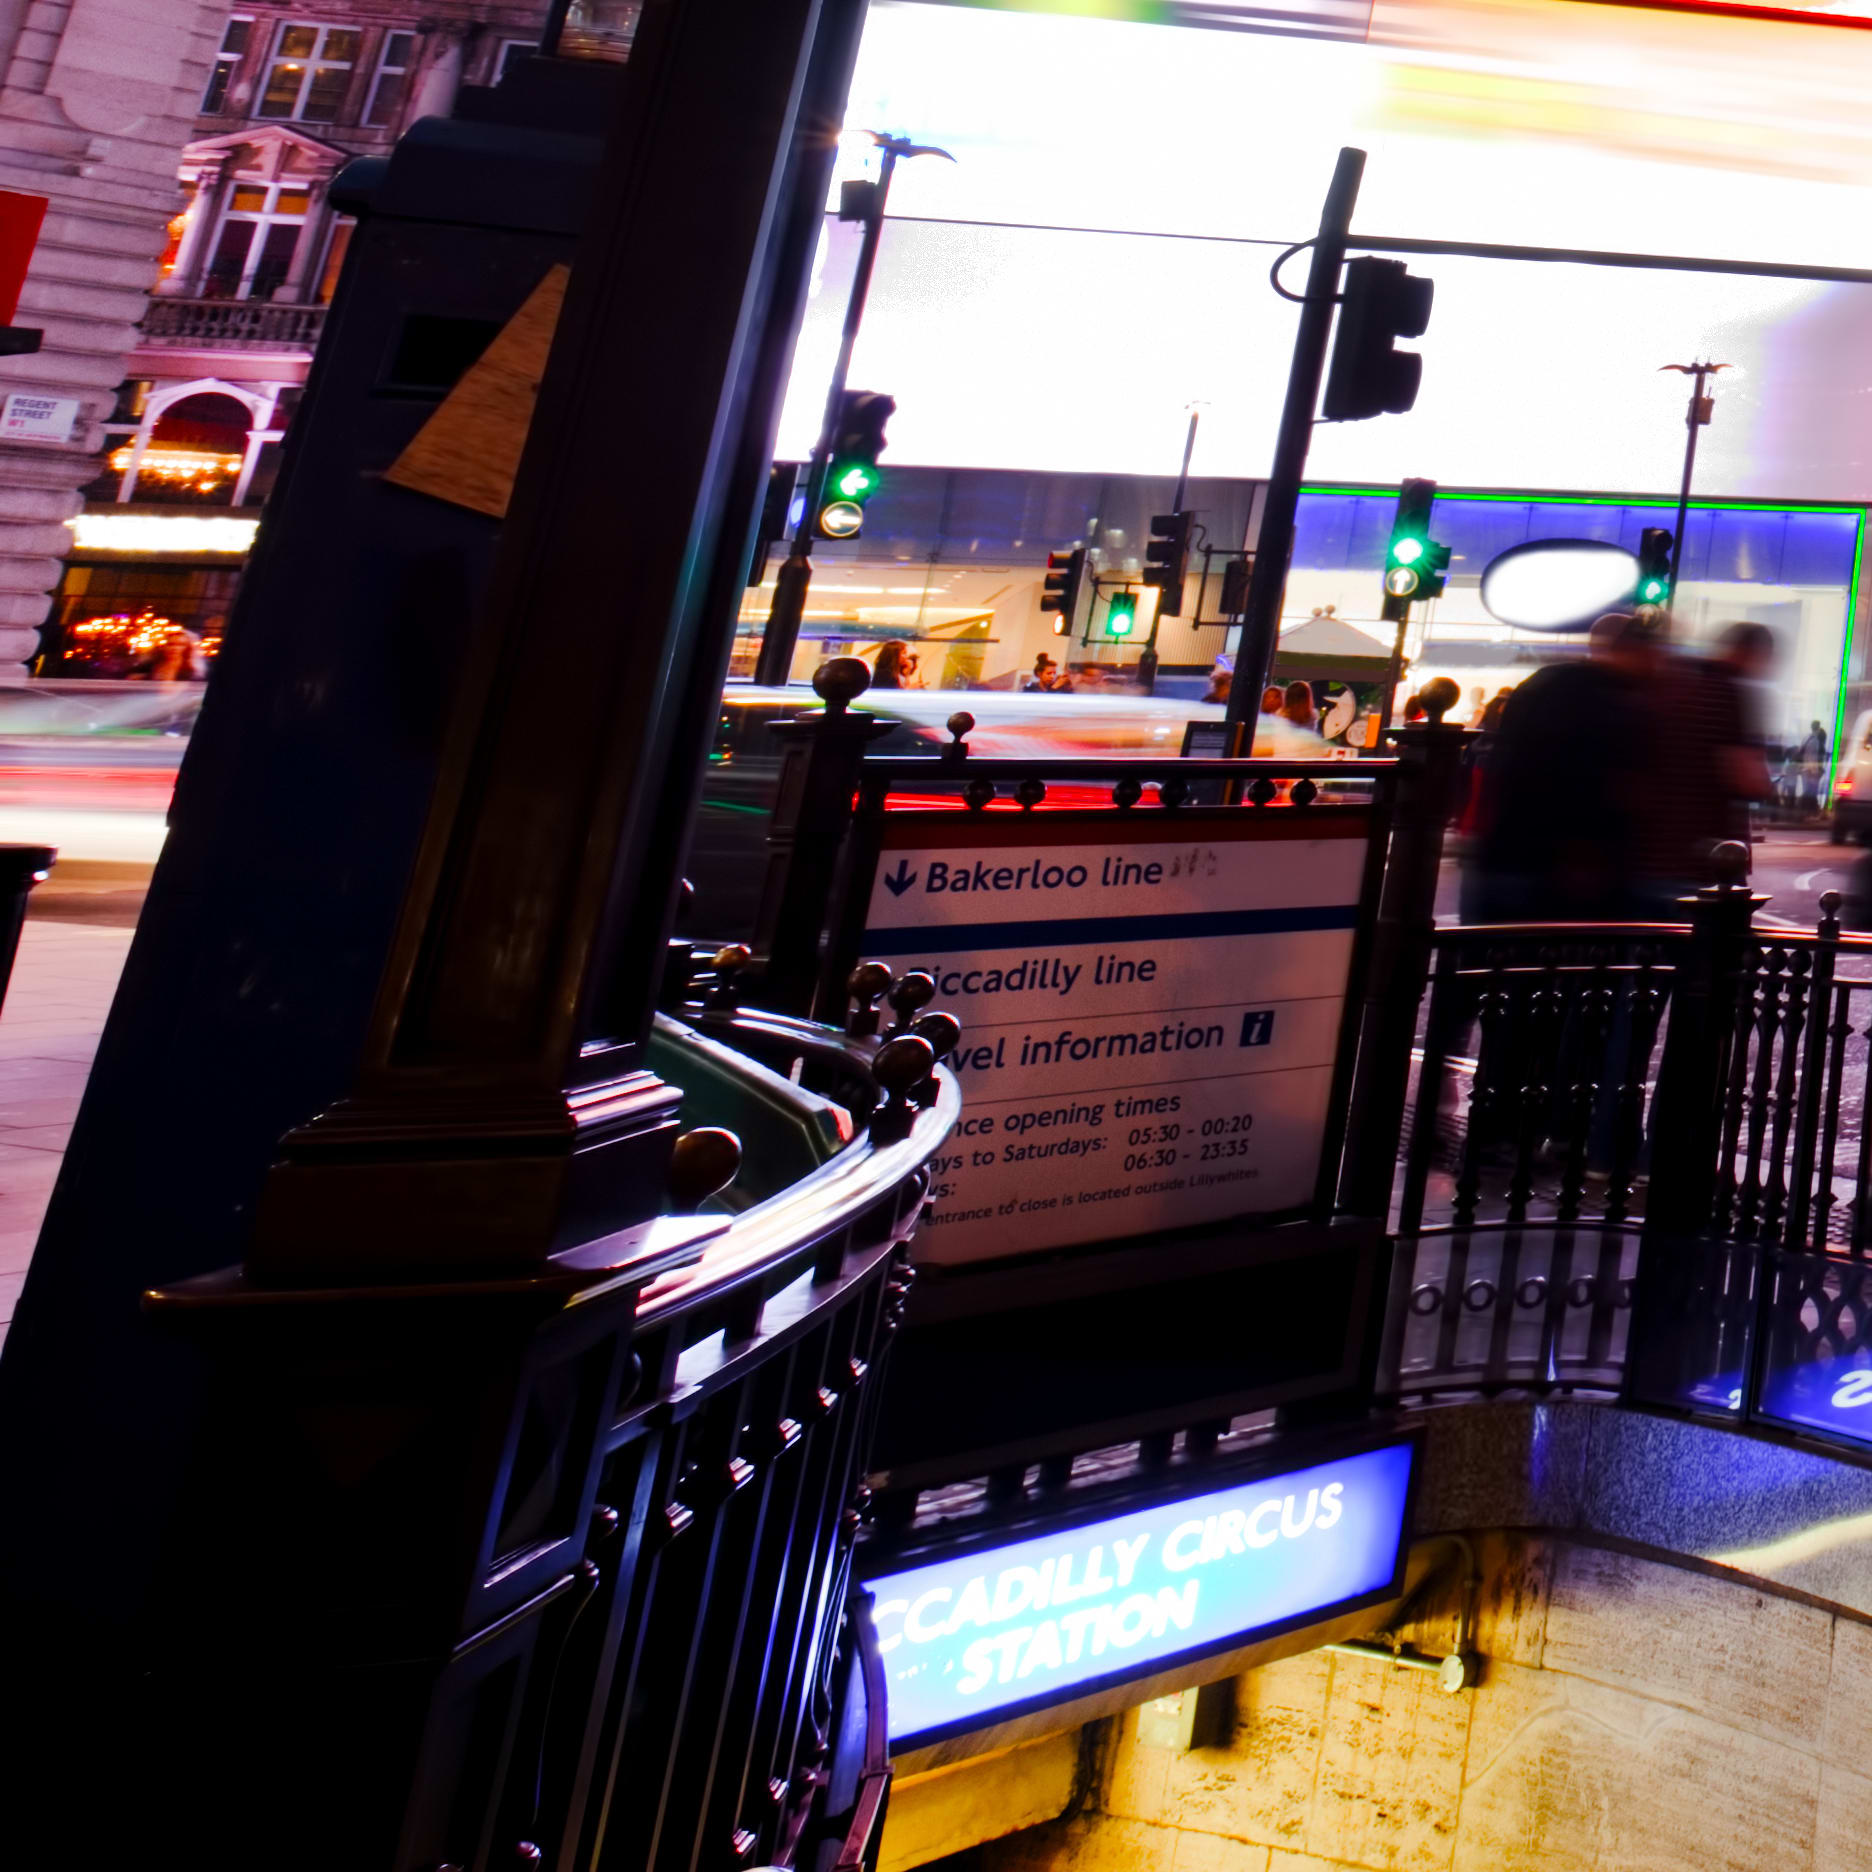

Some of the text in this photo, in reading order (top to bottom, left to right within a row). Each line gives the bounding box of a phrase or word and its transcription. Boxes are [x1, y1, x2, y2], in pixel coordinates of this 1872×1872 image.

[11, 409, 52, 419] STREET
[14, 398, 57, 409] REGENT
[925, 859, 1088, 893] Bakerloo
[1101, 857, 1163, 887] line
[909, 954, 1157, 996] iccadilly line
[944, 1022, 1225, 1073] vel information
[1003, 1103, 1105, 1136] opening
[1114, 1095, 1181, 1119] times
[972, 1149, 996, 1167] to
[1003, 1137, 1109, 1163] Saturdays:
[1128, 1124, 1181, 1147] 05:30
[1201, 1114, 1253, 1137] 00:20
[1123, 1148, 1177, 1172] 06:30
[1199, 1138, 1250, 1162] 23:35
[925, 1167, 1259, 1227] entrance to close is located outside Lillywhites
[871, 1482, 1344, 1654] CCADILLY CIRCUS
[956, 1579, 1199, 1696] STATION
